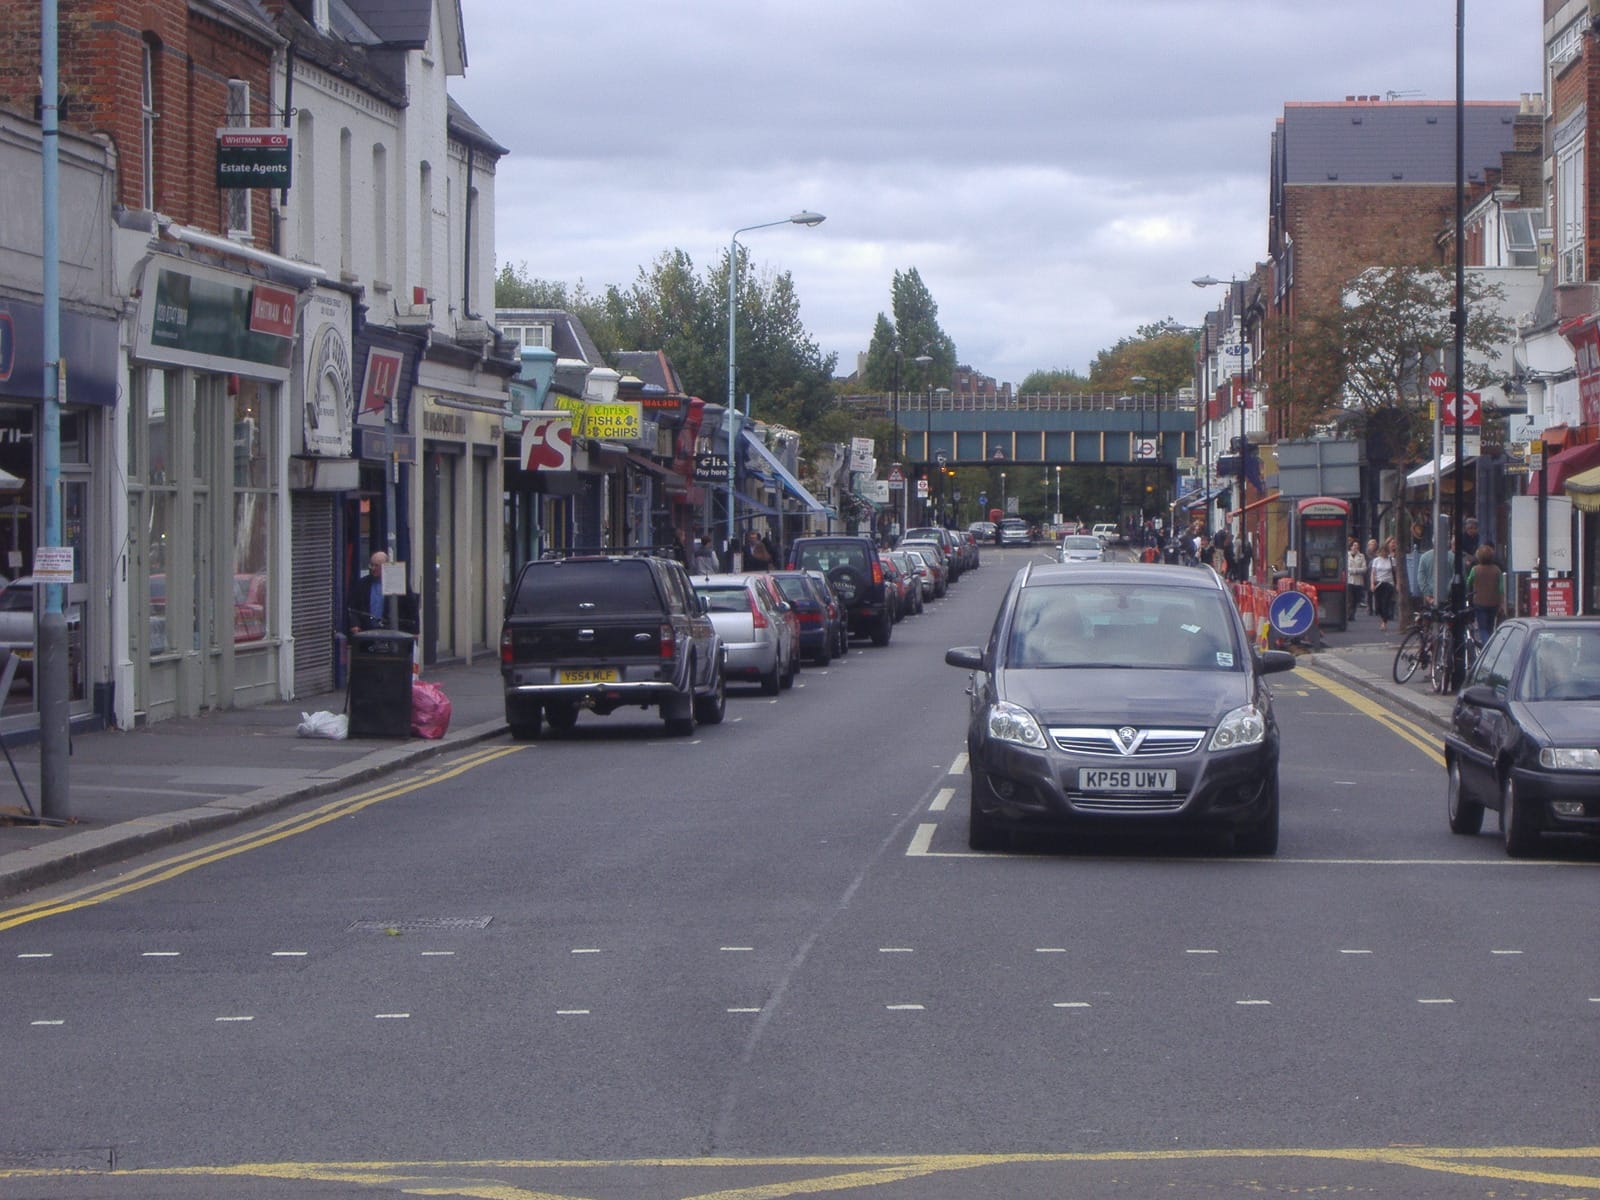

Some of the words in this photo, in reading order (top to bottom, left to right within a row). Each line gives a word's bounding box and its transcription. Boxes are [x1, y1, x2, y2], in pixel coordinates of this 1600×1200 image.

[225, 136, 262, 144] WHITMAN
[270, 136, 284, 144] CO.
[220, 163, 251, 172] Estate
[252, 163, 287, 175] Agents
[1428, 376, 1447, 387] NN
[587, 416, 613, 426] FISH
[615, 416, 624, 426] &
[604, 427, 638, 438] CHIPS
[696, 468, 709, 477] Pay
[711, 468, 727, 476] here
[1086, 772, 1131, 788] KP58
[1135, 772, 1168, 788] UWV
